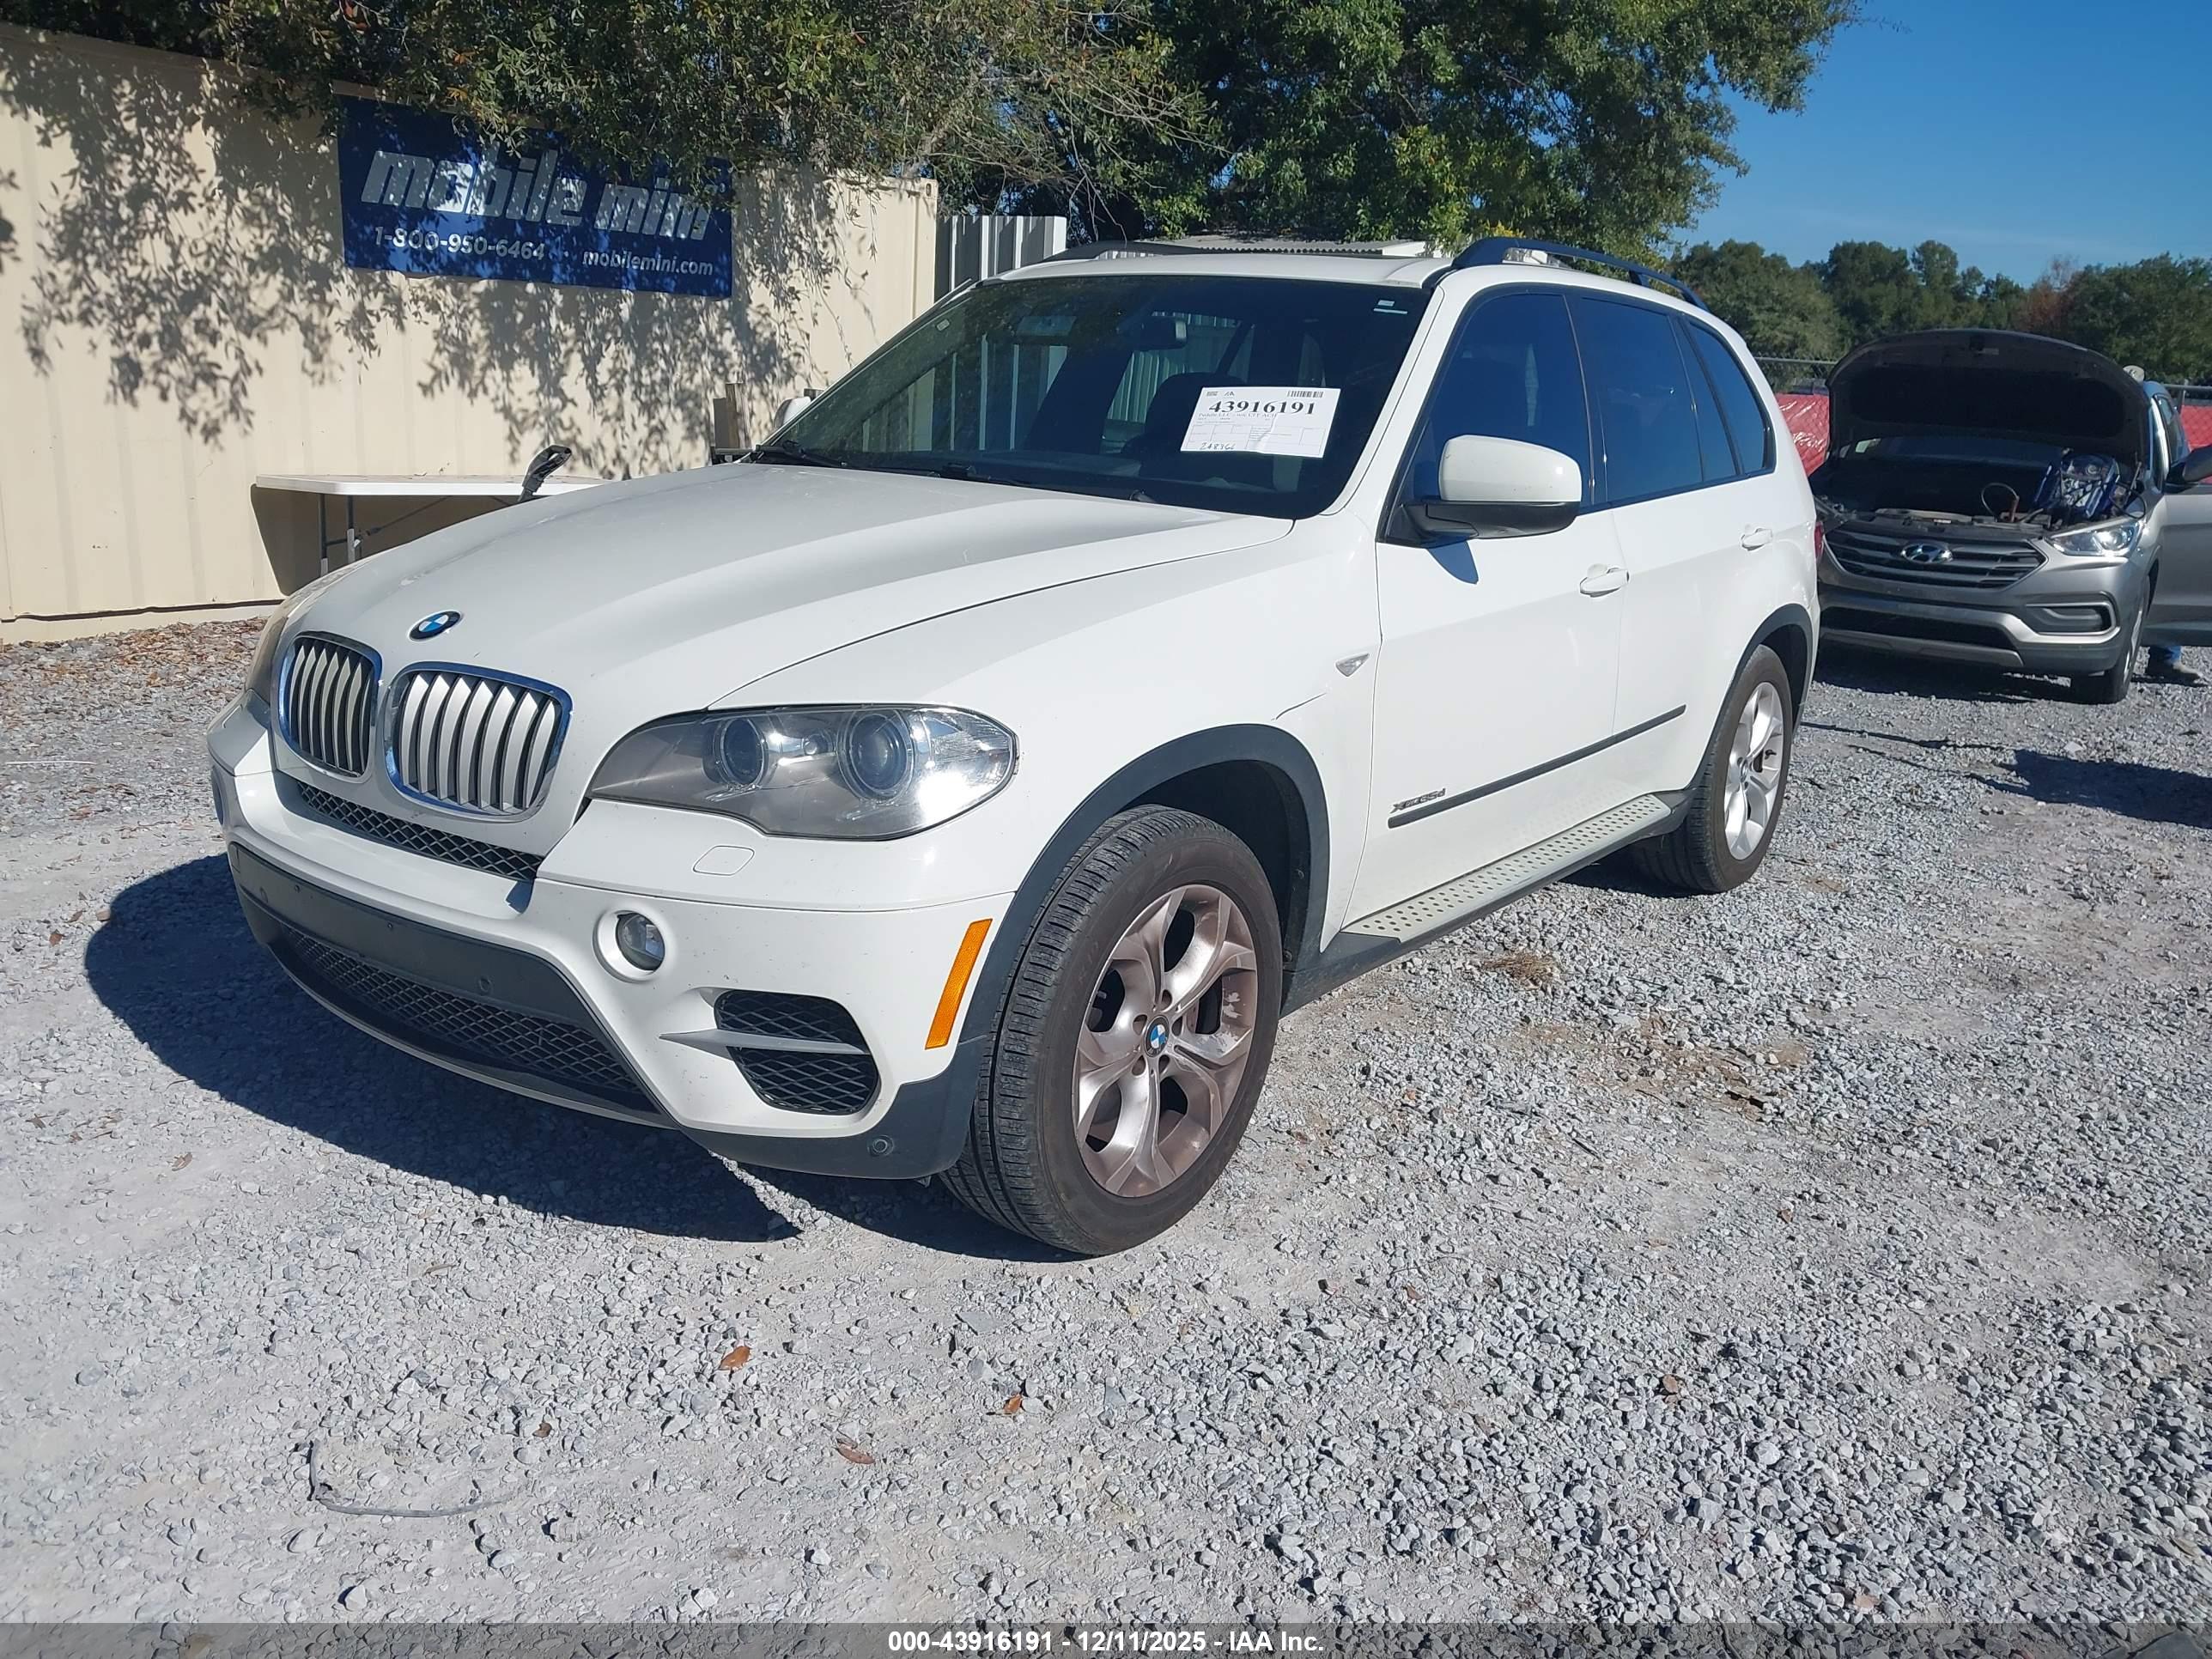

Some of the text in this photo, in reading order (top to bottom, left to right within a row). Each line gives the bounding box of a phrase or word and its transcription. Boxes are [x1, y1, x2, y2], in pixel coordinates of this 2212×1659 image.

[361, 142, 587, 227] mobile
[374, 226, 545, 261] 1-800-950-6464
[583, 249, 714, 276] mobilemini.com
[1208, 400, 1316, 415] 43916191
